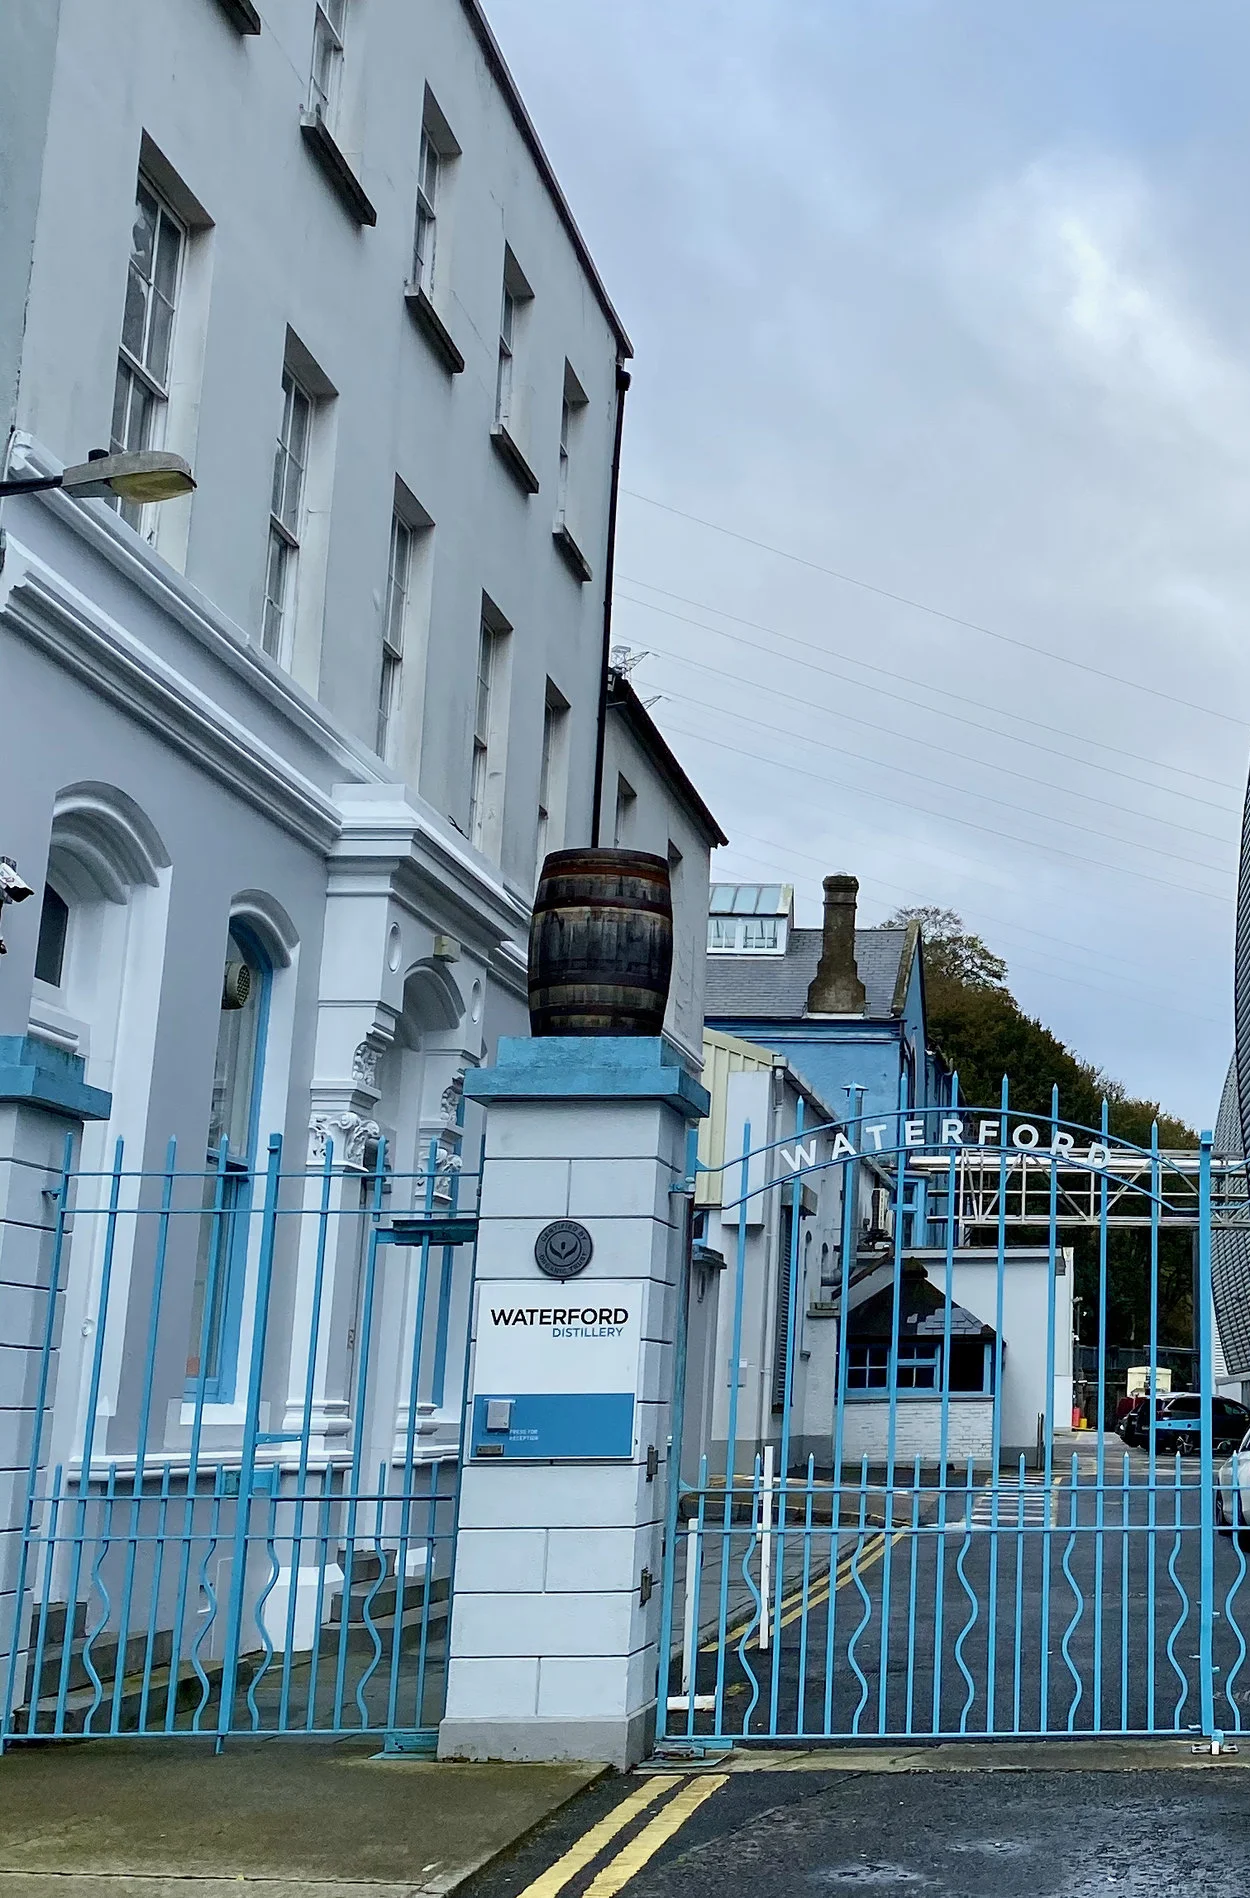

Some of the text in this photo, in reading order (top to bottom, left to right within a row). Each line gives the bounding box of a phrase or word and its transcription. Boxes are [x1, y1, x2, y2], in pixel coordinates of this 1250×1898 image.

[780, 1119, 1112, 1171] WATERFORD
[491, 1308, 629, 1326] WATERFORD
[552, 1327, 624, 1338] DISTILLERY
